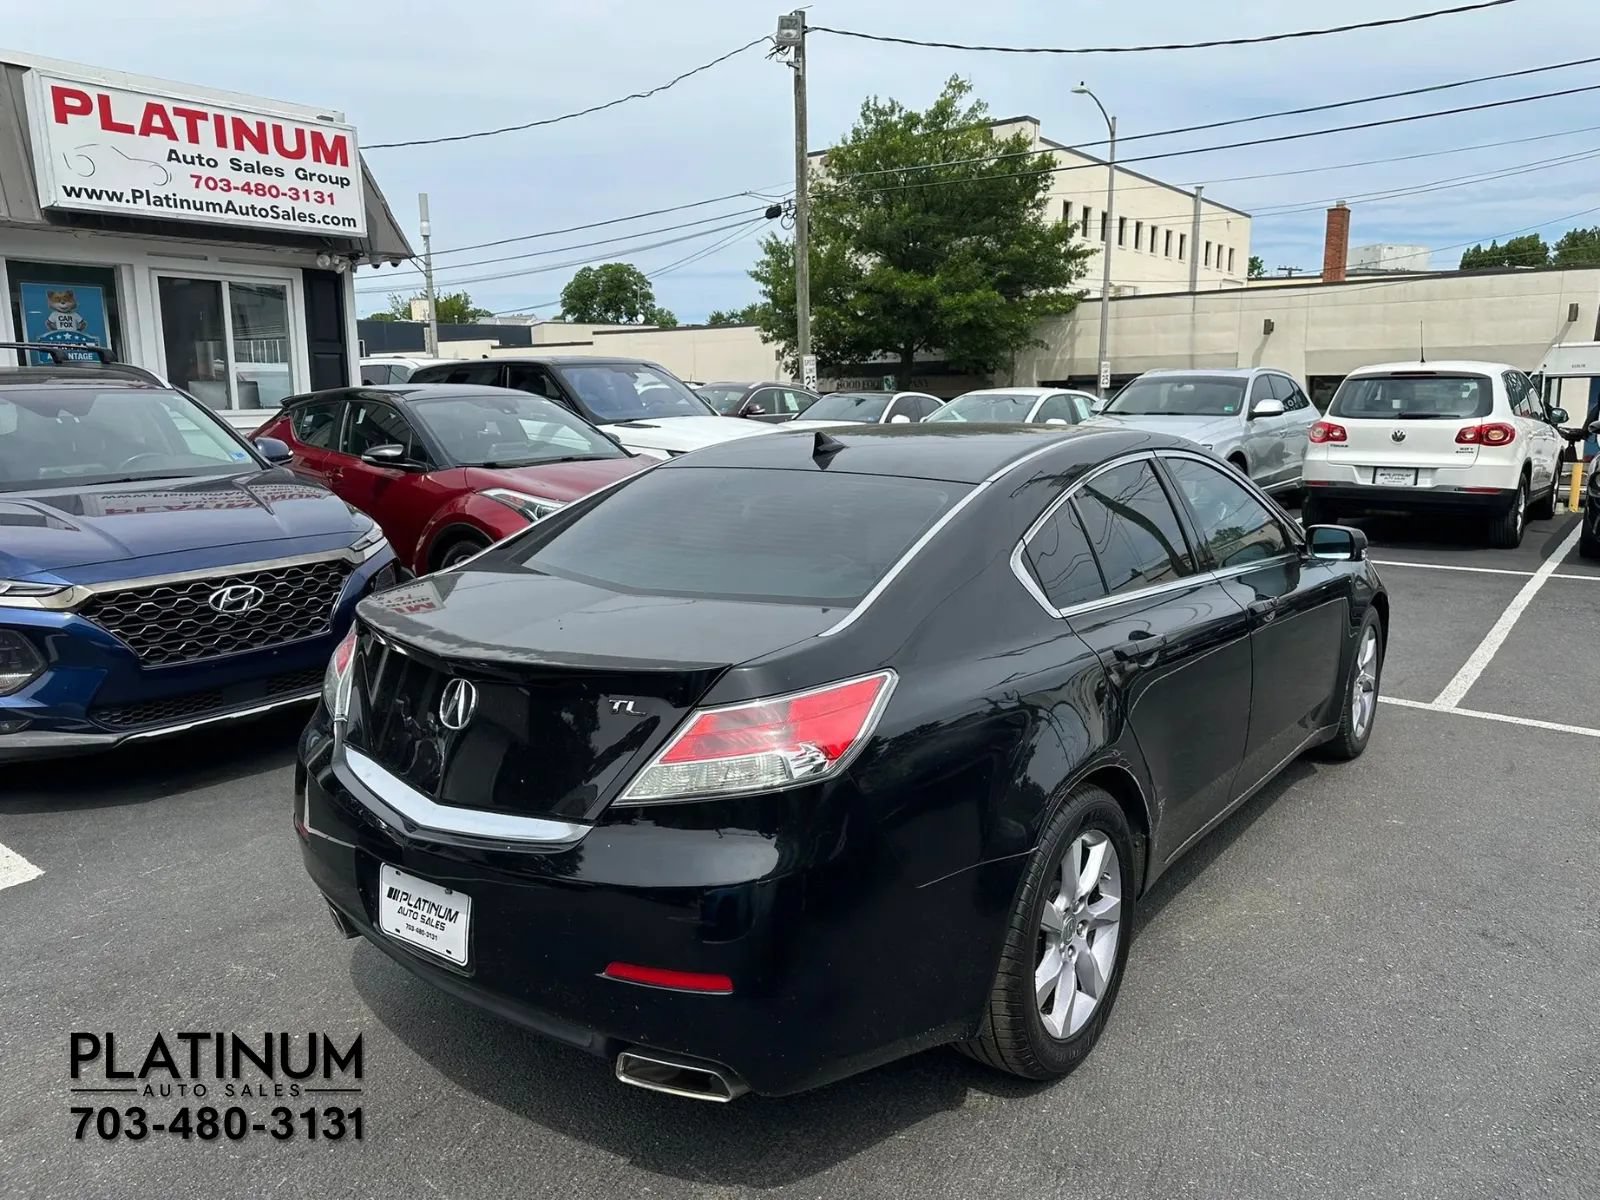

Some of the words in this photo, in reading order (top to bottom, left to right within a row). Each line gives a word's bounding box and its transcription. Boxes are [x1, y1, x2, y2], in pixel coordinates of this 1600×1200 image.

[50, 85, 349, 168] PLATINUM
[166, 148, 219, 169] Auto
[229, 157, 285, 178] Sales
[295, 167, 351, 188] Group
[62, 184, 357, 228] www.PlatinumAutoSales.com
[190, 174, 336, 206] 703-480-3131
[609, 699, 646, 715] TL
[397, 906, 419, 921] AUTO
[420, 914, 446, 932] SALES
[399, 891, 459, 924] PLATINUM
